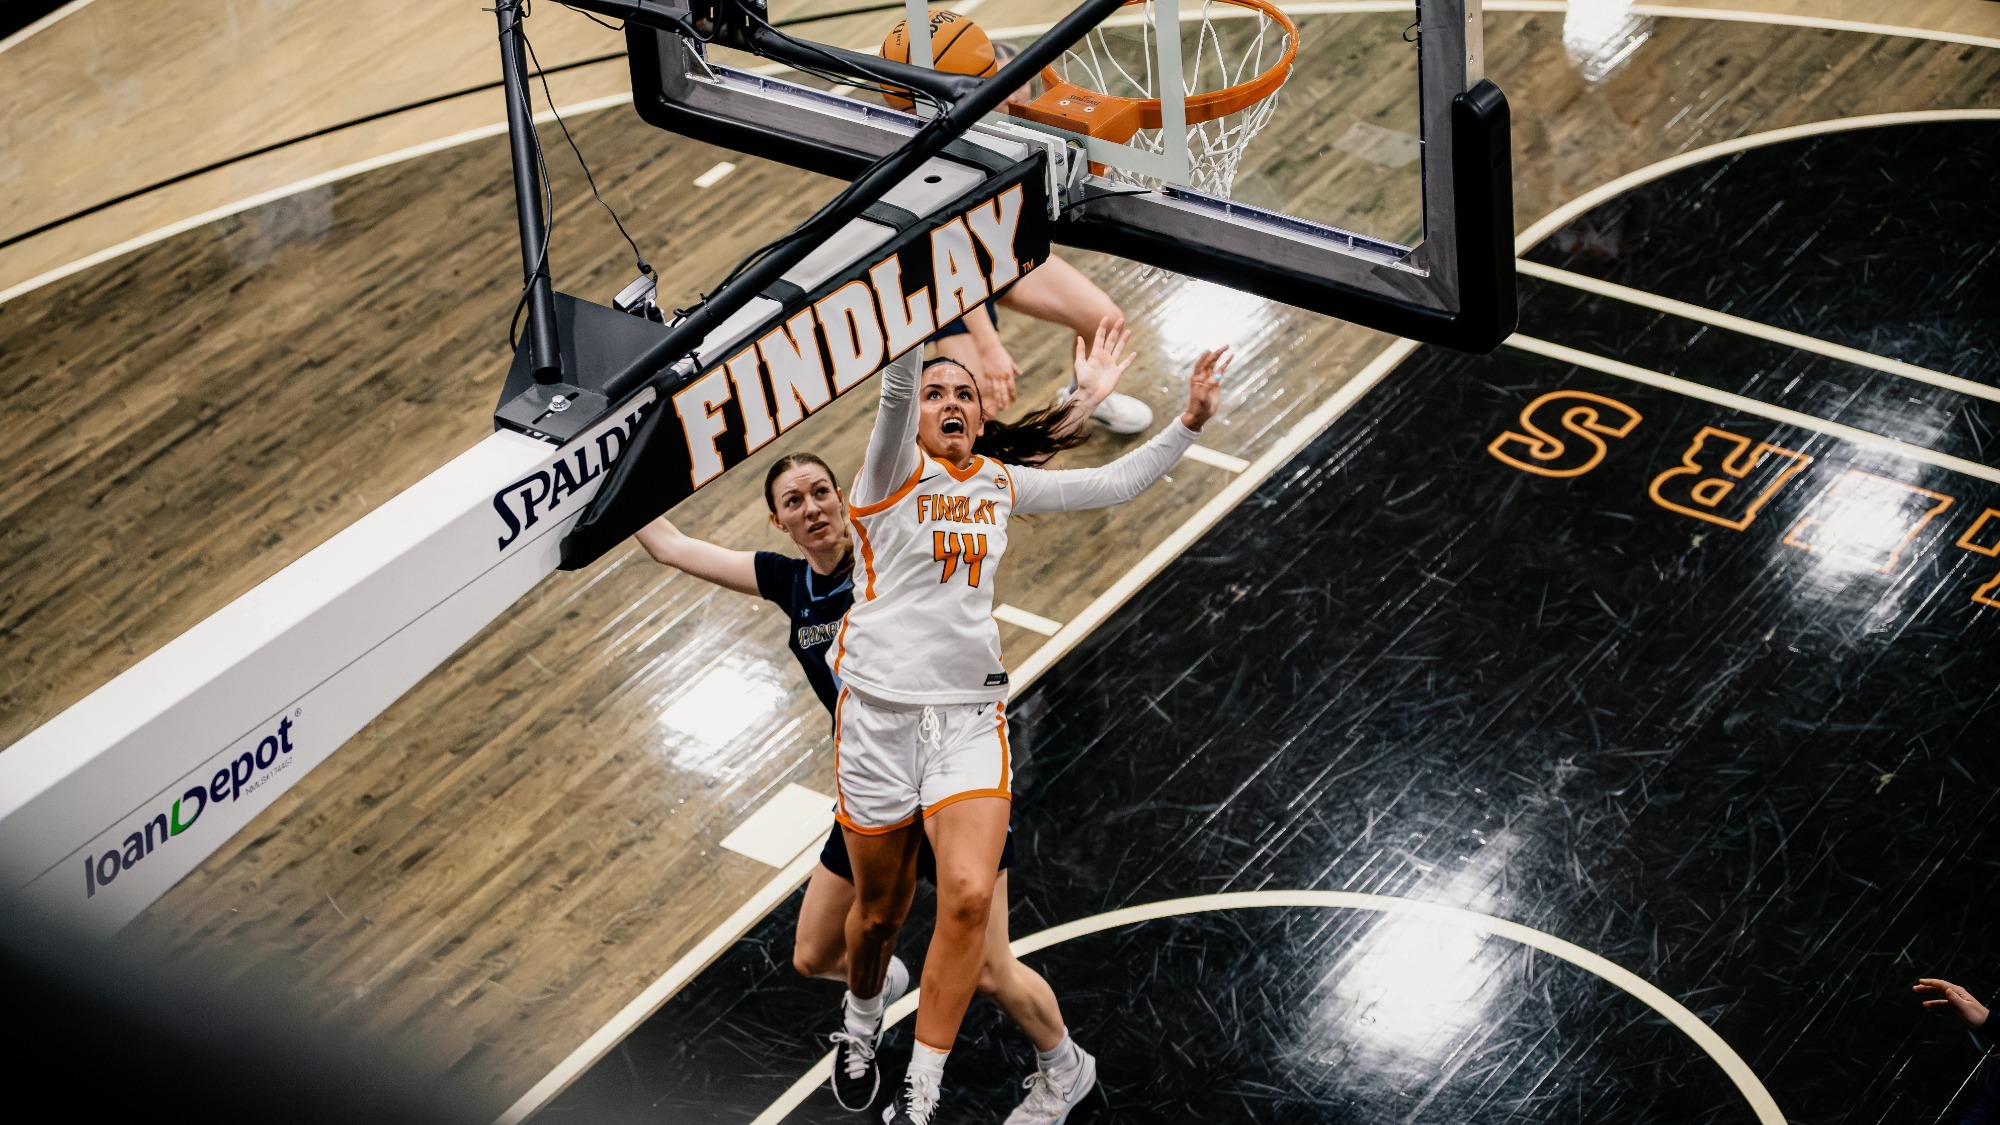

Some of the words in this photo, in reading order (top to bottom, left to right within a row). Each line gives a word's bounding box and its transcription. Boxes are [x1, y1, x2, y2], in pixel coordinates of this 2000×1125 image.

[672, 183, 1025, 490] FINDLAY
[917, 494, 999, 525] FINDLAY
[933, 530, 988, 588] 44
[84, 715, 293, 899] loanDepot
